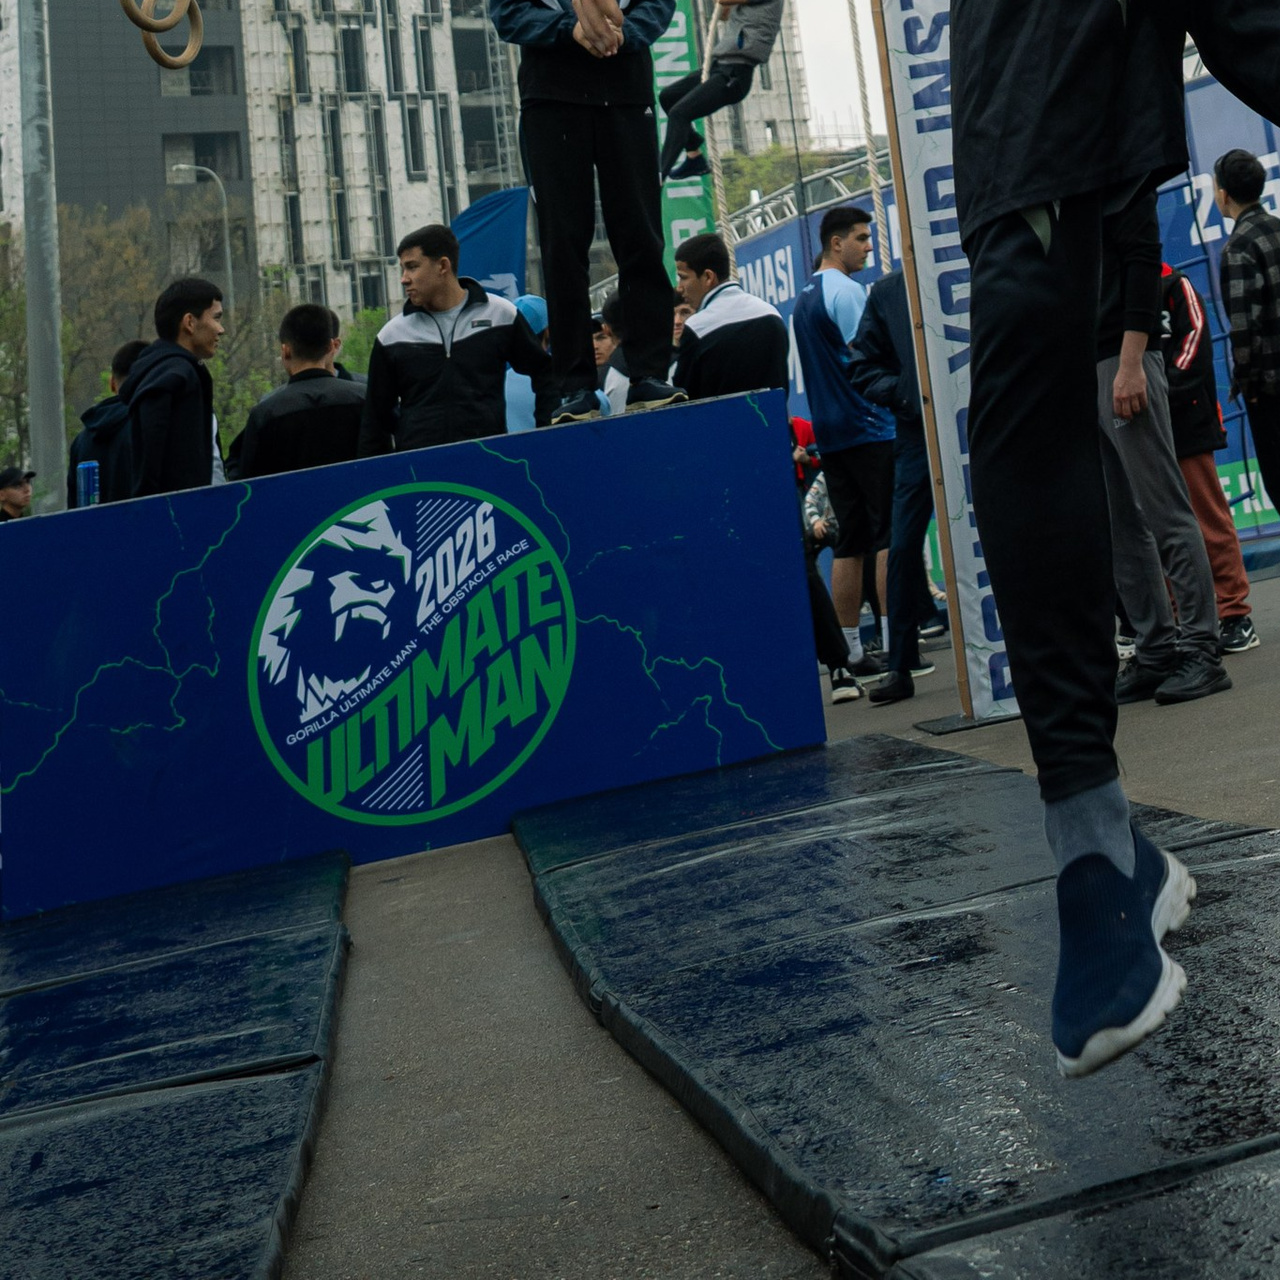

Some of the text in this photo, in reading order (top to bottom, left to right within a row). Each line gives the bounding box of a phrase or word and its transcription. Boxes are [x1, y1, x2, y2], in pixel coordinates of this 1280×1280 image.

[286, 710, 339, 745] GORILLA
[339, 666, 393, 713] ULTIMATE
[420, 612, 444, 635] THE
[441, 561, 497, 614] OBSTACLE
[496, 538, 530, 565] RACE
[415, 500, 496, 628] 2026
[306, 552, 562, 803] ULTIMATE
[428, 623, 567, 808] MAN
